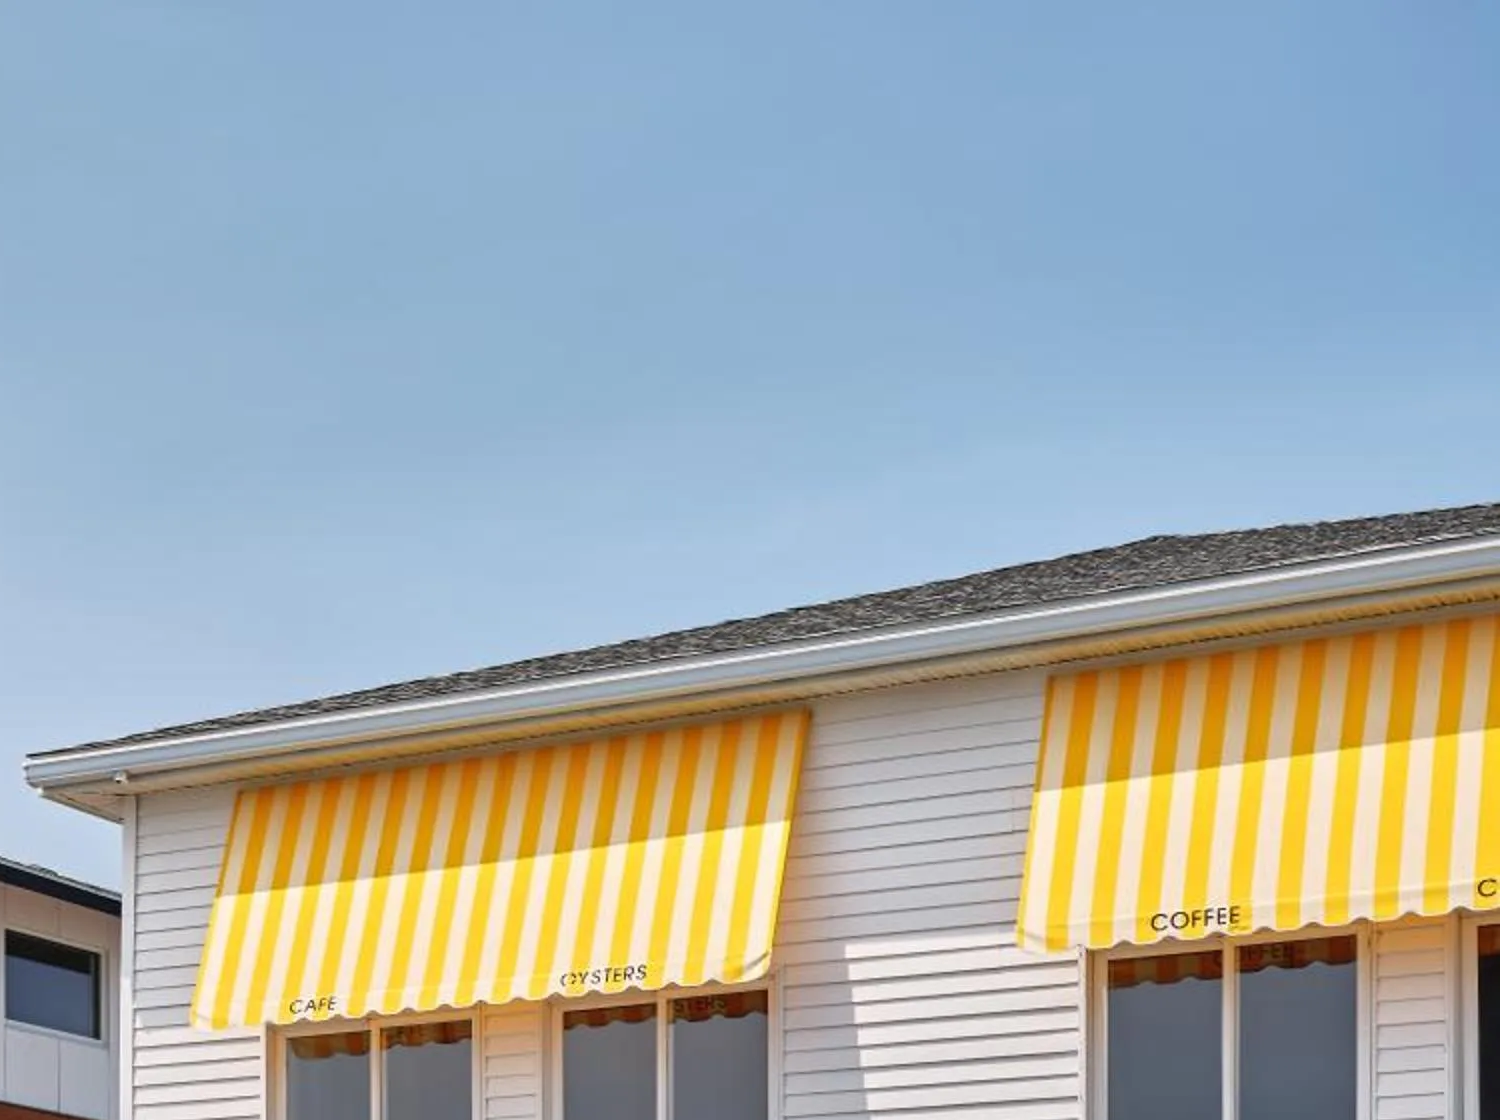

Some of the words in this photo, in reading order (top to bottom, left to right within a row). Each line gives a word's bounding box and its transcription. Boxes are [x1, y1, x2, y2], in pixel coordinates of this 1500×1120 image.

[1150, 905, 1241, 932] COFFEE
[559, 964, 647, 986] OYSTERS
[289, 995, 338, 1015] CAFE
